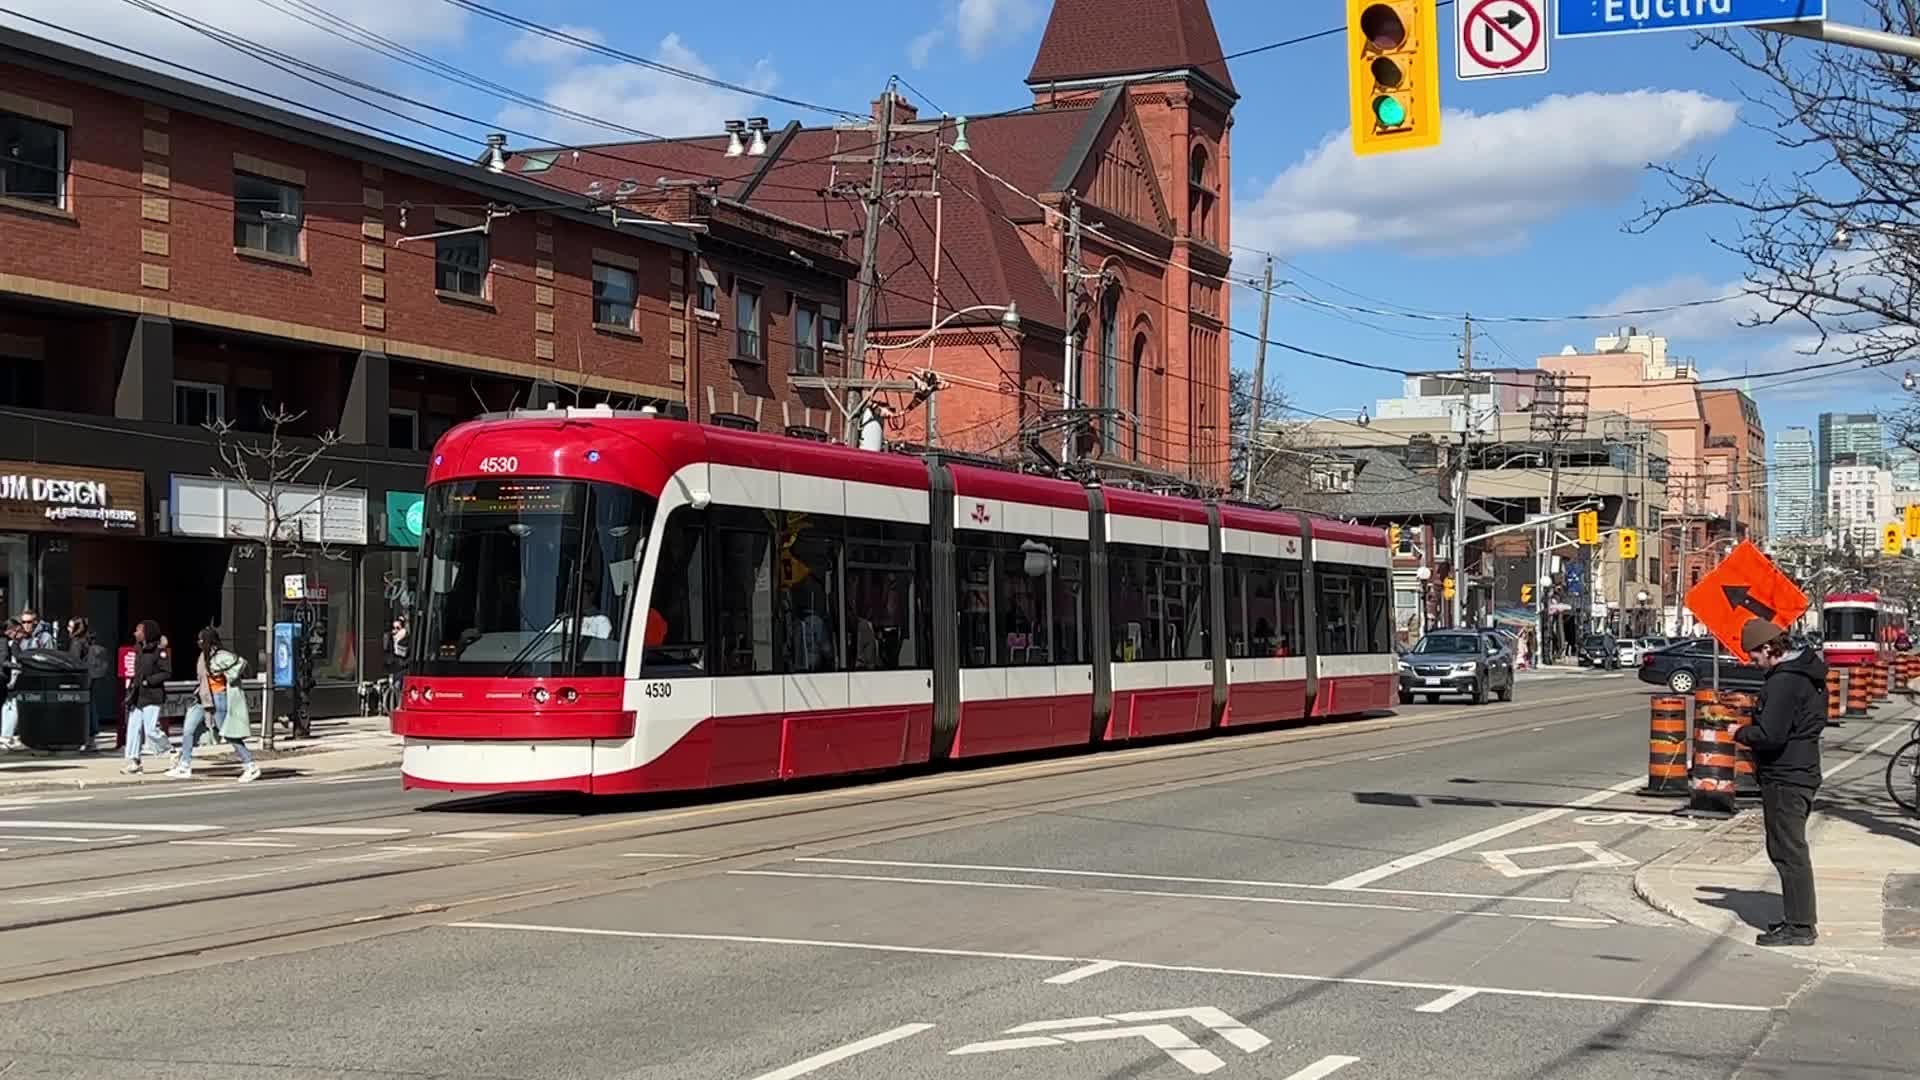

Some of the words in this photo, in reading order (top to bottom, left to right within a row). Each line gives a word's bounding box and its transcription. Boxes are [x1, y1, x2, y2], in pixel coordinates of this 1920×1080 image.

[479, 457, 518, 472] 4530
[32, 478, 106, 507] DESIGN
[645, 683, 672, 698] 4530
